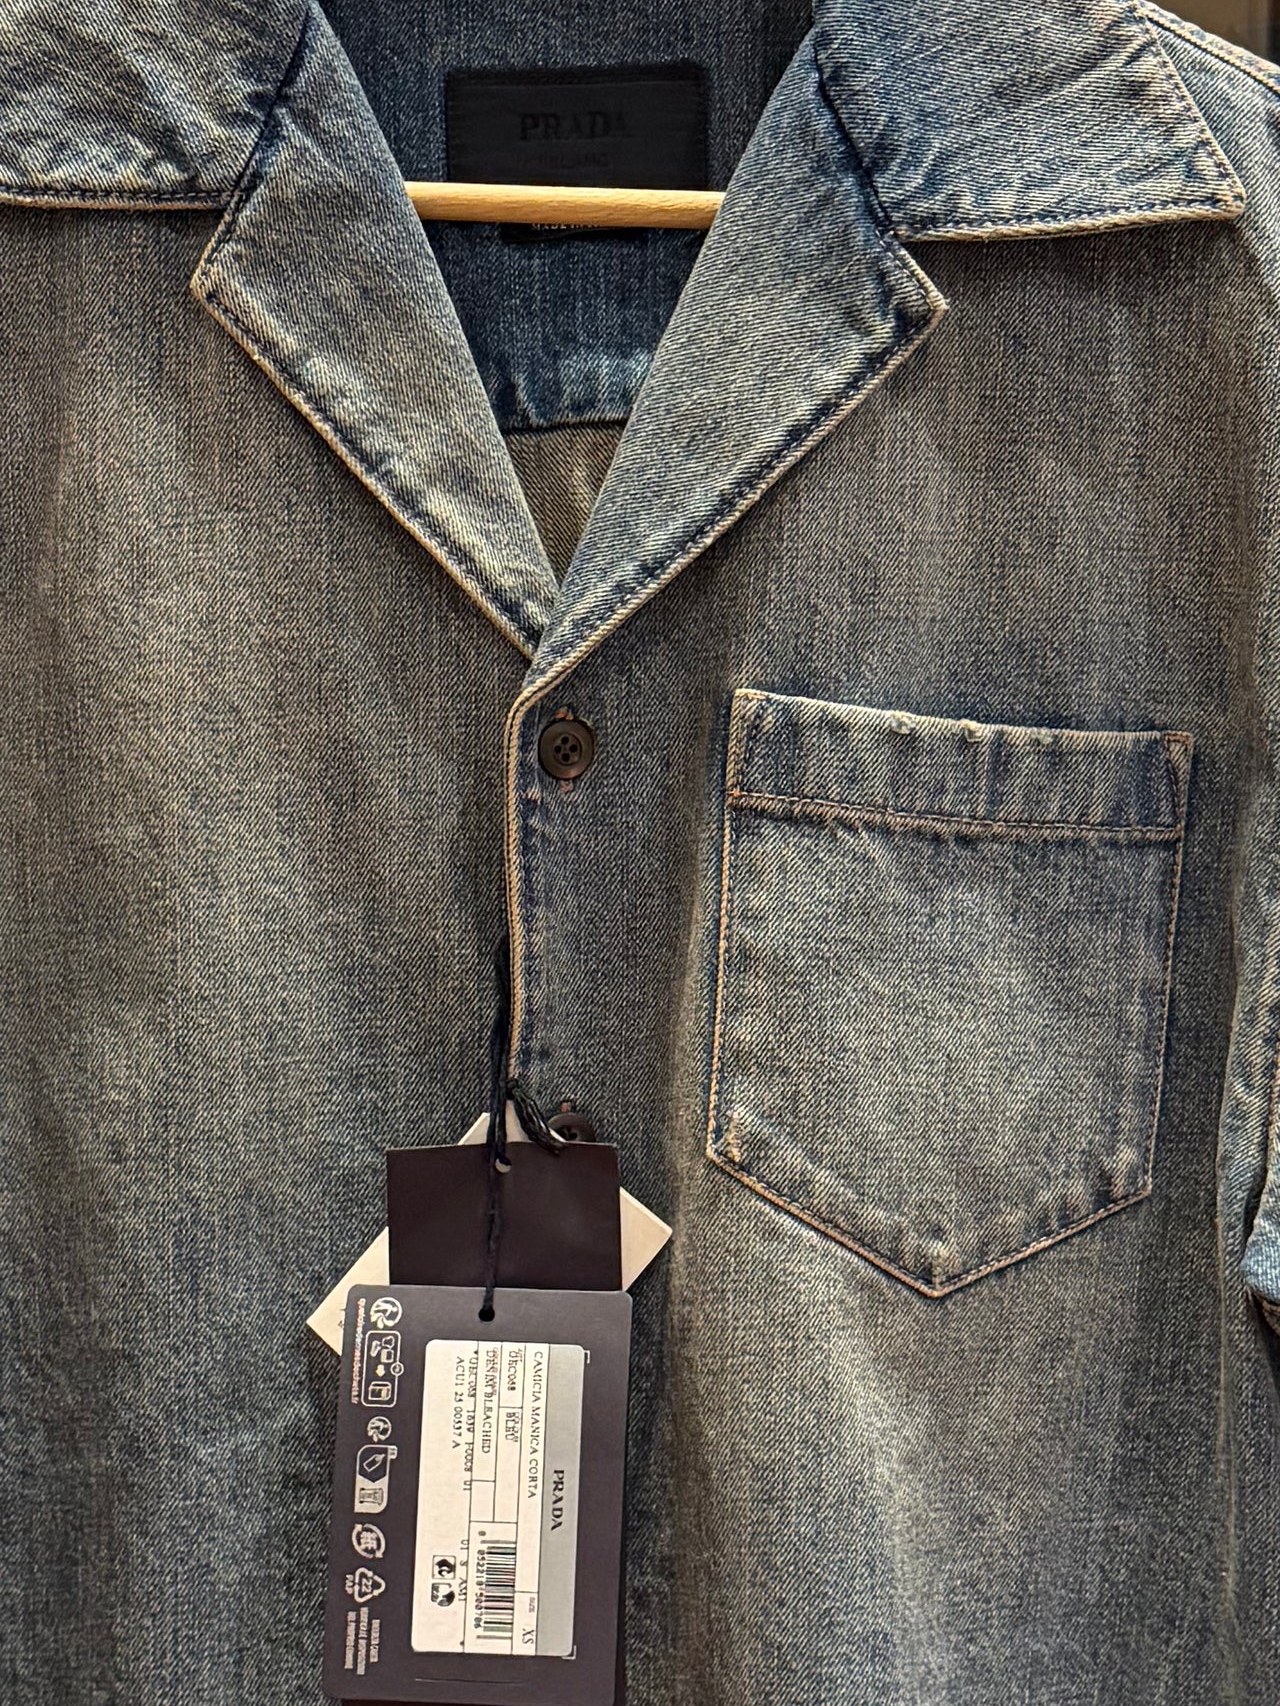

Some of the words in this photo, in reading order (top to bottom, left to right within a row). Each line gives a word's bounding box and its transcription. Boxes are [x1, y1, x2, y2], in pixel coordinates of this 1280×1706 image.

[518, 111, 633, 141] PRADA
[484, 1349, 496, 1388] DENIM
[532, 1350, 544, 1403] CAMICIA
[481, 1391, 494, 1454] BLEACHED
[504, 1411, 516, 1442] BLEU
[529, 1405, 542, 1455] MANICA
[527, 1458, 539, 1499] CORTA
[551, 1469, 565, 1531] PRADA
[345, 1574, 354, 1595] PAP
[361, 1577, 373, 1594] 22
[522, 1627, 535, 1645] XS
